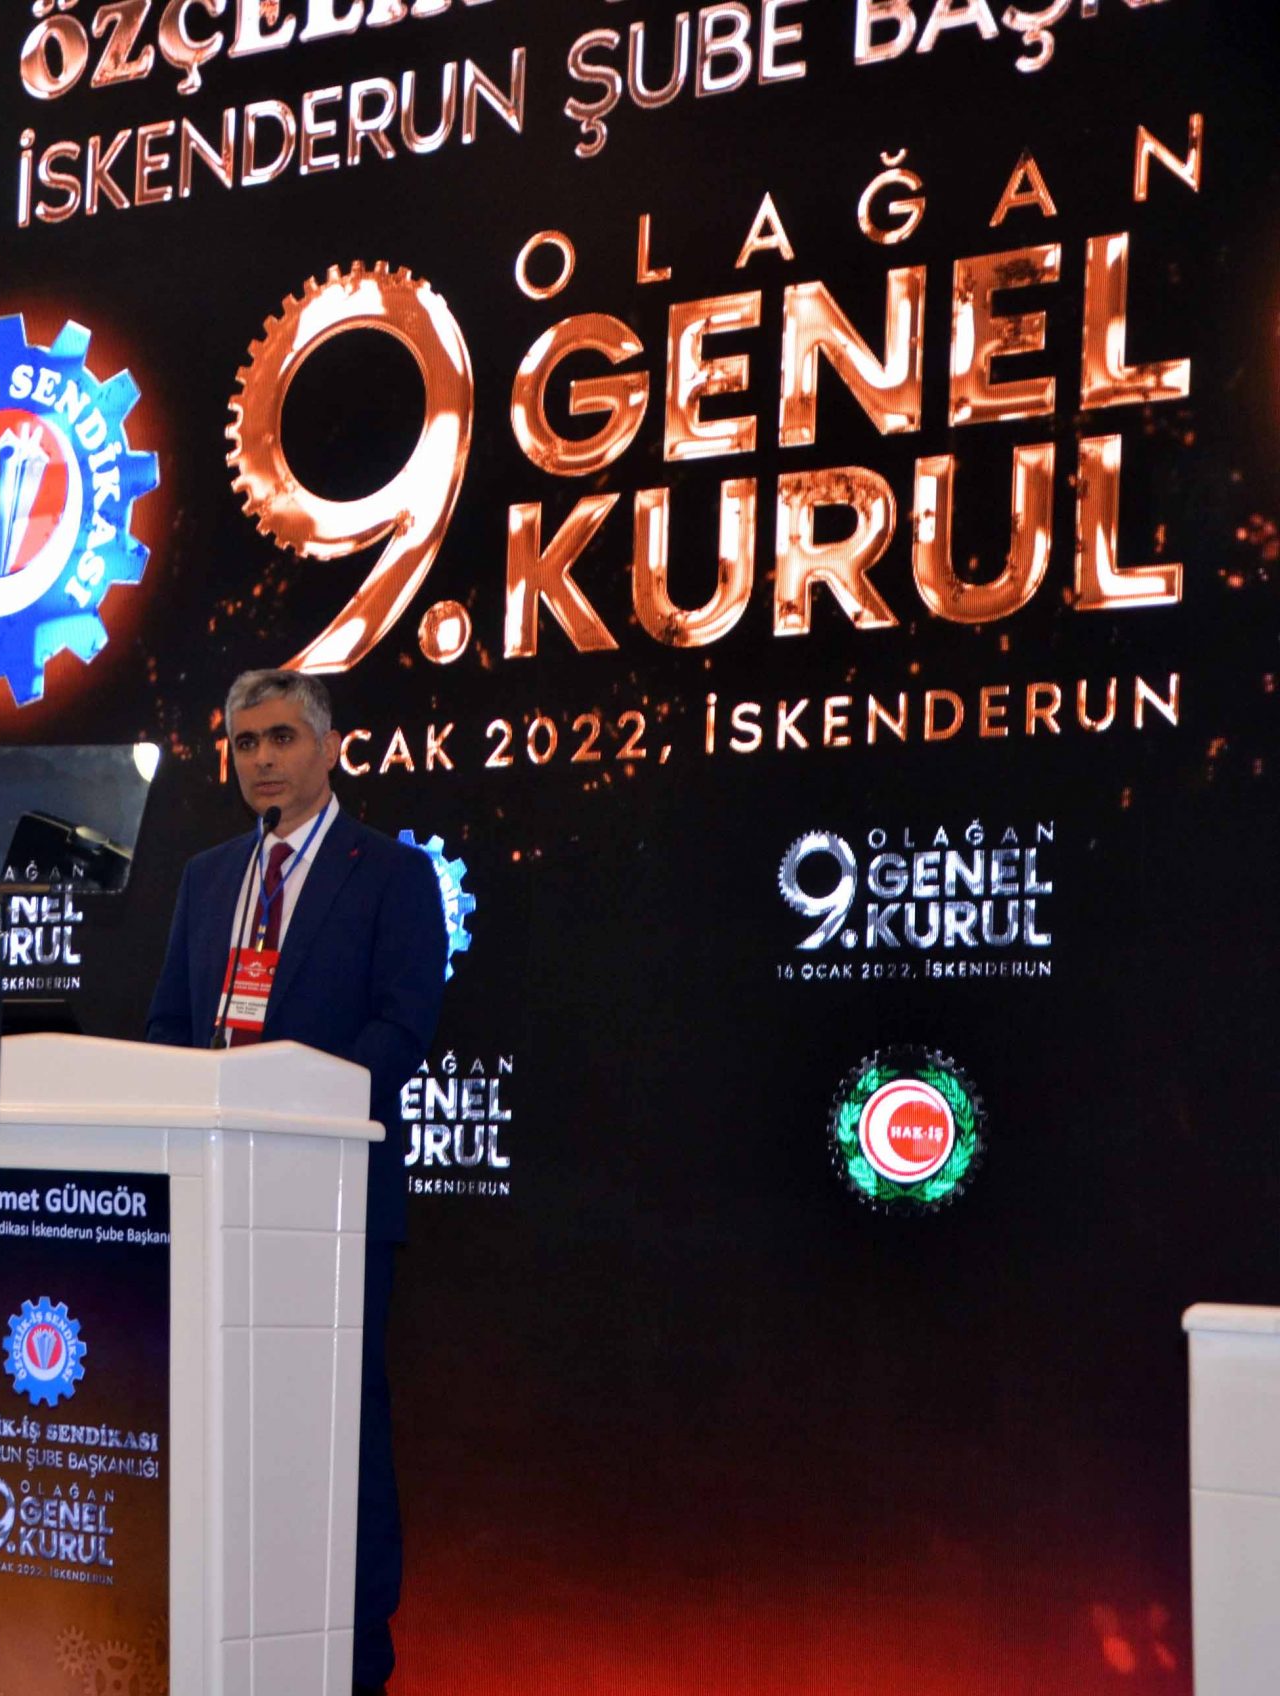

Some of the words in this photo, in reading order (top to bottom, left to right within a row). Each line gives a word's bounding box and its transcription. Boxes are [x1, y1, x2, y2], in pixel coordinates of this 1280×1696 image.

[18, 46, 526, 228] İSKENDERUN
[563, 5, 807, 158] ŞUBE
[515, 113, 1204, 300] OLAĞAN
[511, 232, 1191, 477] GENEL
[9, 364, 125, 608] SENDİKASI
[225, 259, 474, 674] 9.
[504, 434, 1183, 659] KURUL
[340, 722, 456, 776] CAK
[484, 712, 672, 769] 2022,
[705, 673, 1180, 755] İSKENDERUN
[867, 818, 1055, 848] OLAĞAN
[867, 847, 1053, 898] GENEL
[866, 898, 1052, 948] KURUL
[1, 976, 81, 991] SKENDERUN
[801, 961, 853, 979] OCAK
[925, 959, 1053, 977] İSKENDERUN
[417, 1049, 513, 1075] AĞAN
[400, 1077, 512, 1121] ENEL
[45, 1183, 147, 1217] GÜNGÖR
[31, 1220, 93, 1240] İskenderun
[95, 1225, 124, 1244] Şube
[45, 1424, 159, 1451] SENDİKASI
[25, 1448, 63, 1471] ŞUBE
[20, 1496, 113, 1535] GENEL
[20, 1526, 113, 1566] KURUL
